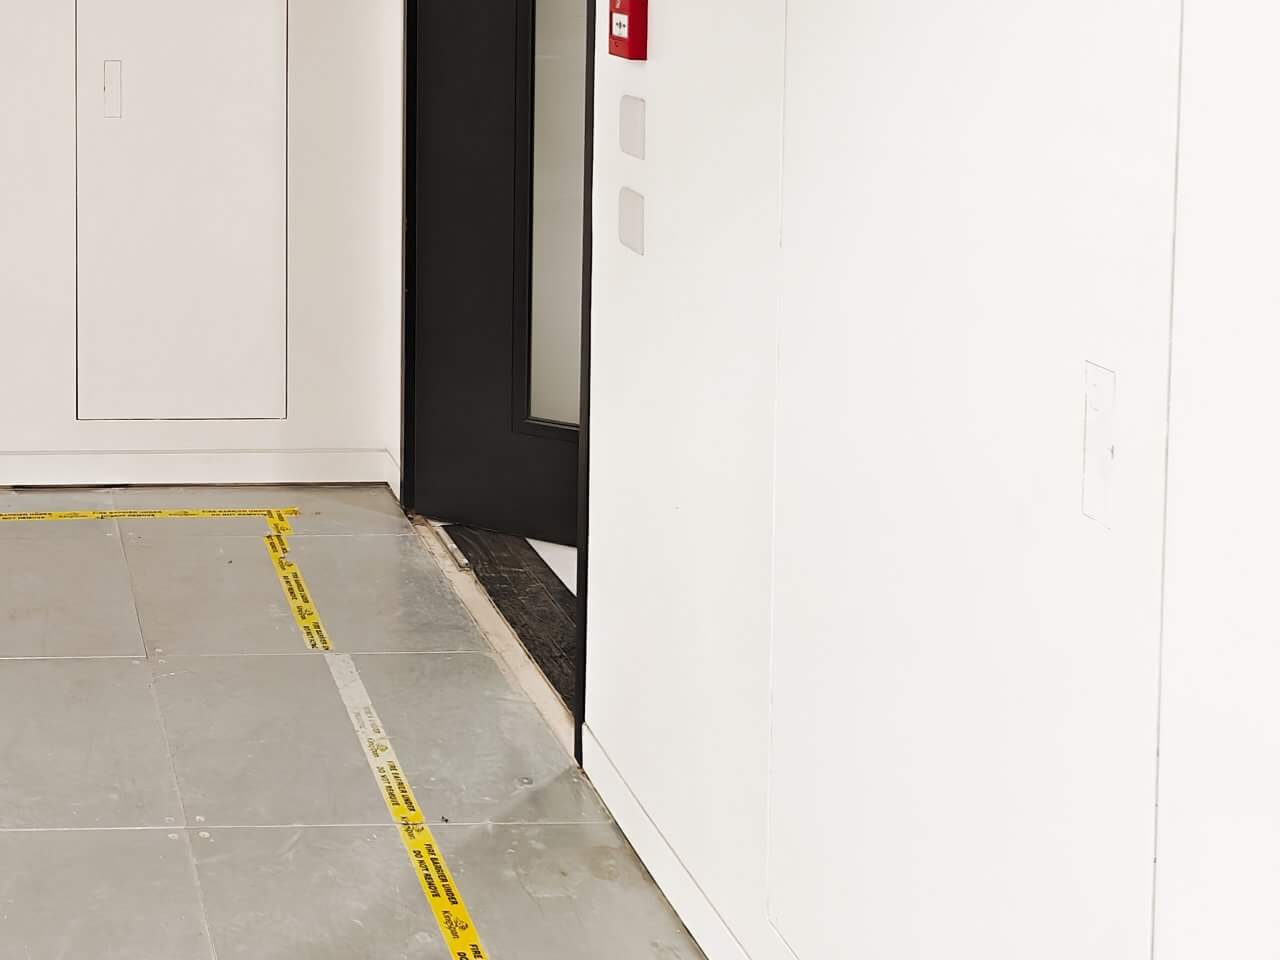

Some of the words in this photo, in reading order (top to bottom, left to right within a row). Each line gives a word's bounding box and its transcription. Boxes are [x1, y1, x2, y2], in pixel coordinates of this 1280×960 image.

[413, 850, 424, 859] DO
[424, 843, 437, 856] FIRE
[417, 859, 430, 872] NOT
